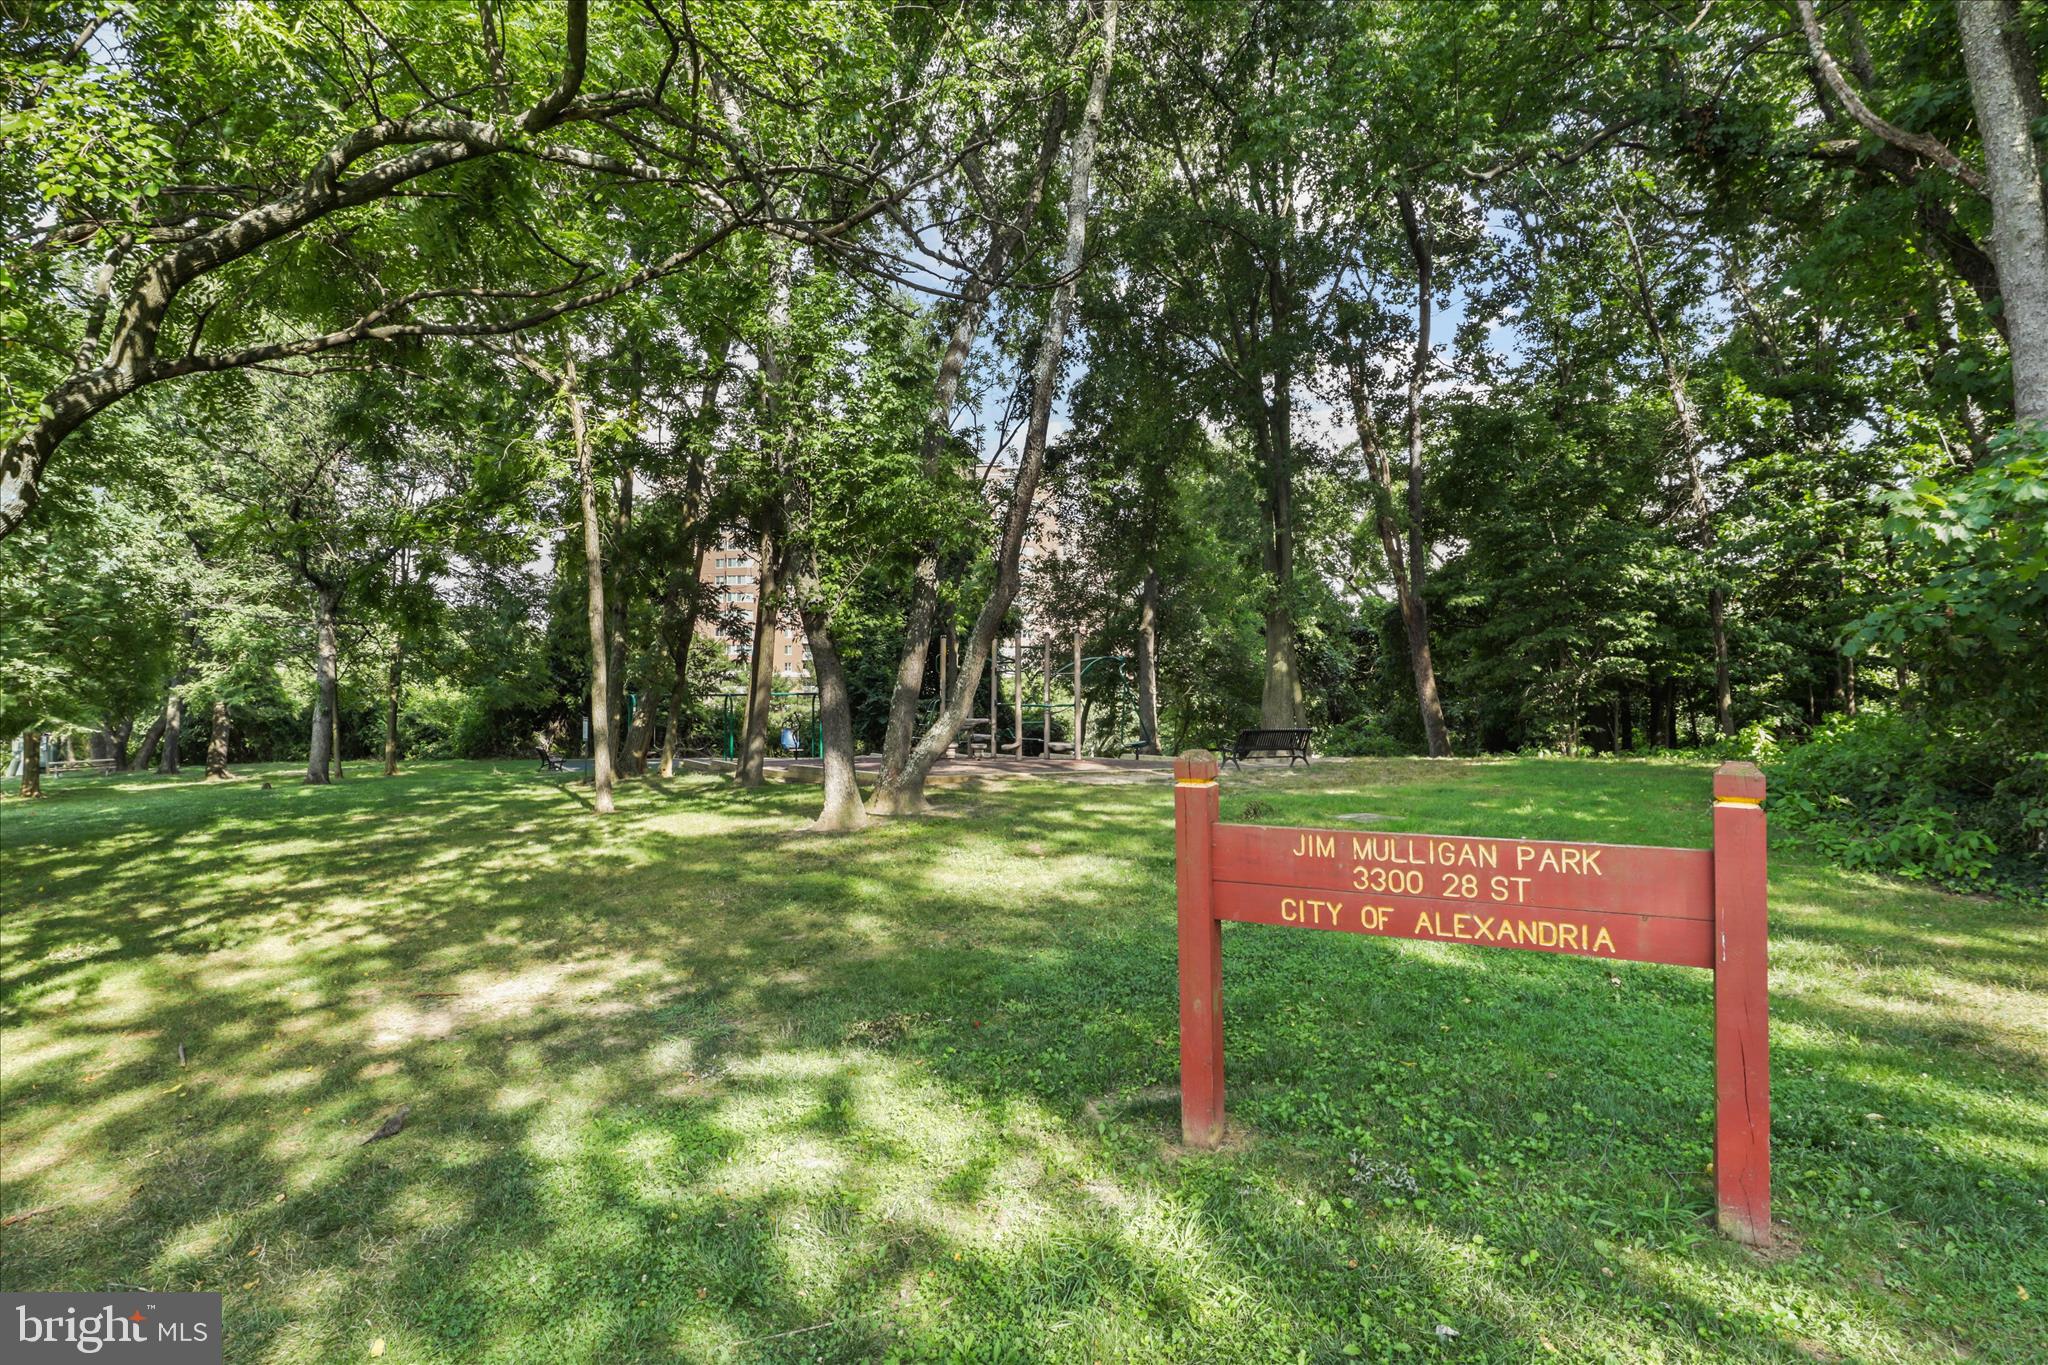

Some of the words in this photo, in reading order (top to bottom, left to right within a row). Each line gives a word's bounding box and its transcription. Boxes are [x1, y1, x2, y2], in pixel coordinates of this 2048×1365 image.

[1293, 834, 1335, 858] JIM
[1353, 837, 1497, 868] MULLIGAN
[1516, 846, 1602, 876] PARK
[1352, 866, 1424, 894] 3300
[1442, 873, 1478, 898] 28
[1491, 876, 1531, 902] ST
[1281, 898, 1343, 926] CITY
[1361, 905, 1394, 930] OF
[1415, 912, 1616, 953] ALEXANDRIA
